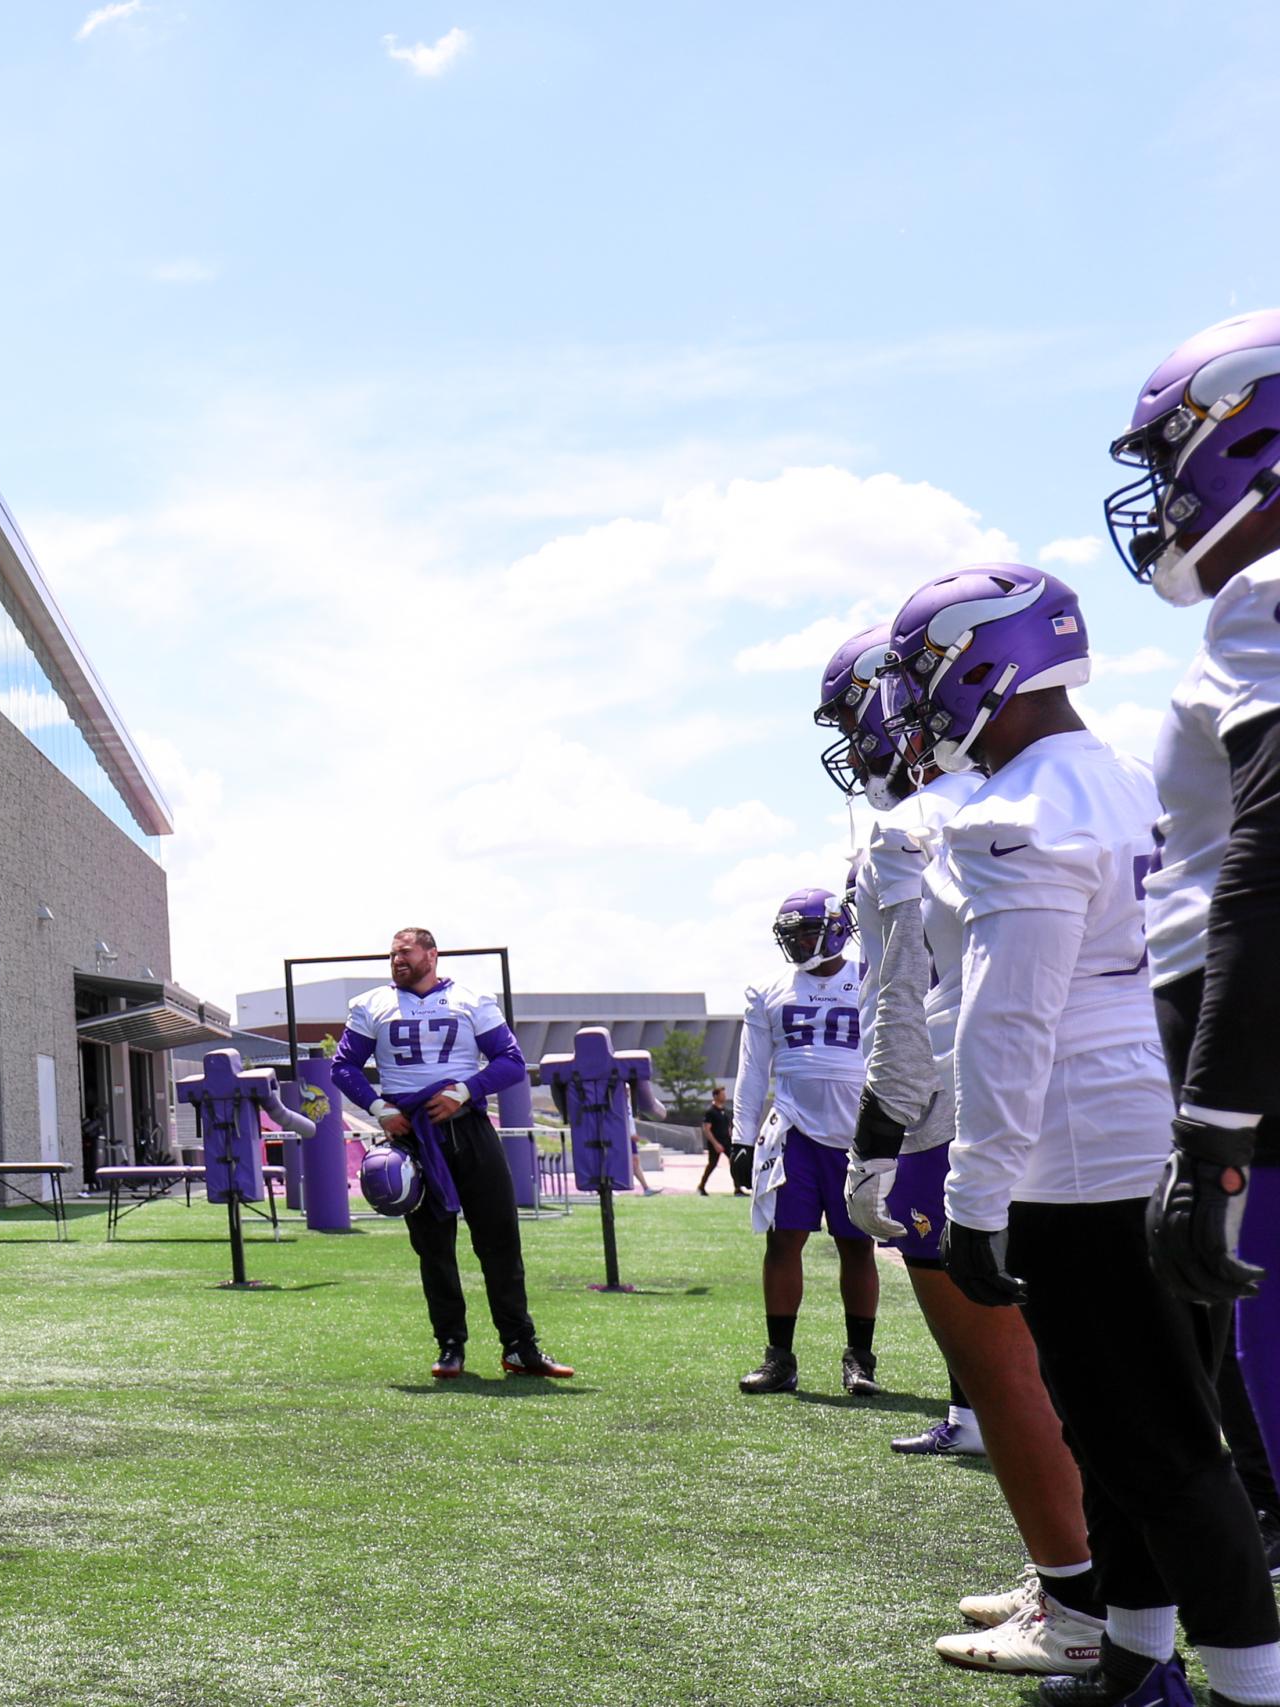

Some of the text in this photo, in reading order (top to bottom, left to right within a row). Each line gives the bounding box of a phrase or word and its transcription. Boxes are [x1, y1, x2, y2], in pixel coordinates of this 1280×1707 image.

[389, 1018, 459, 1067] 97
[782, 1005, 860, 1050] 50
[1079, 1648, 1102, 1657] NITR
